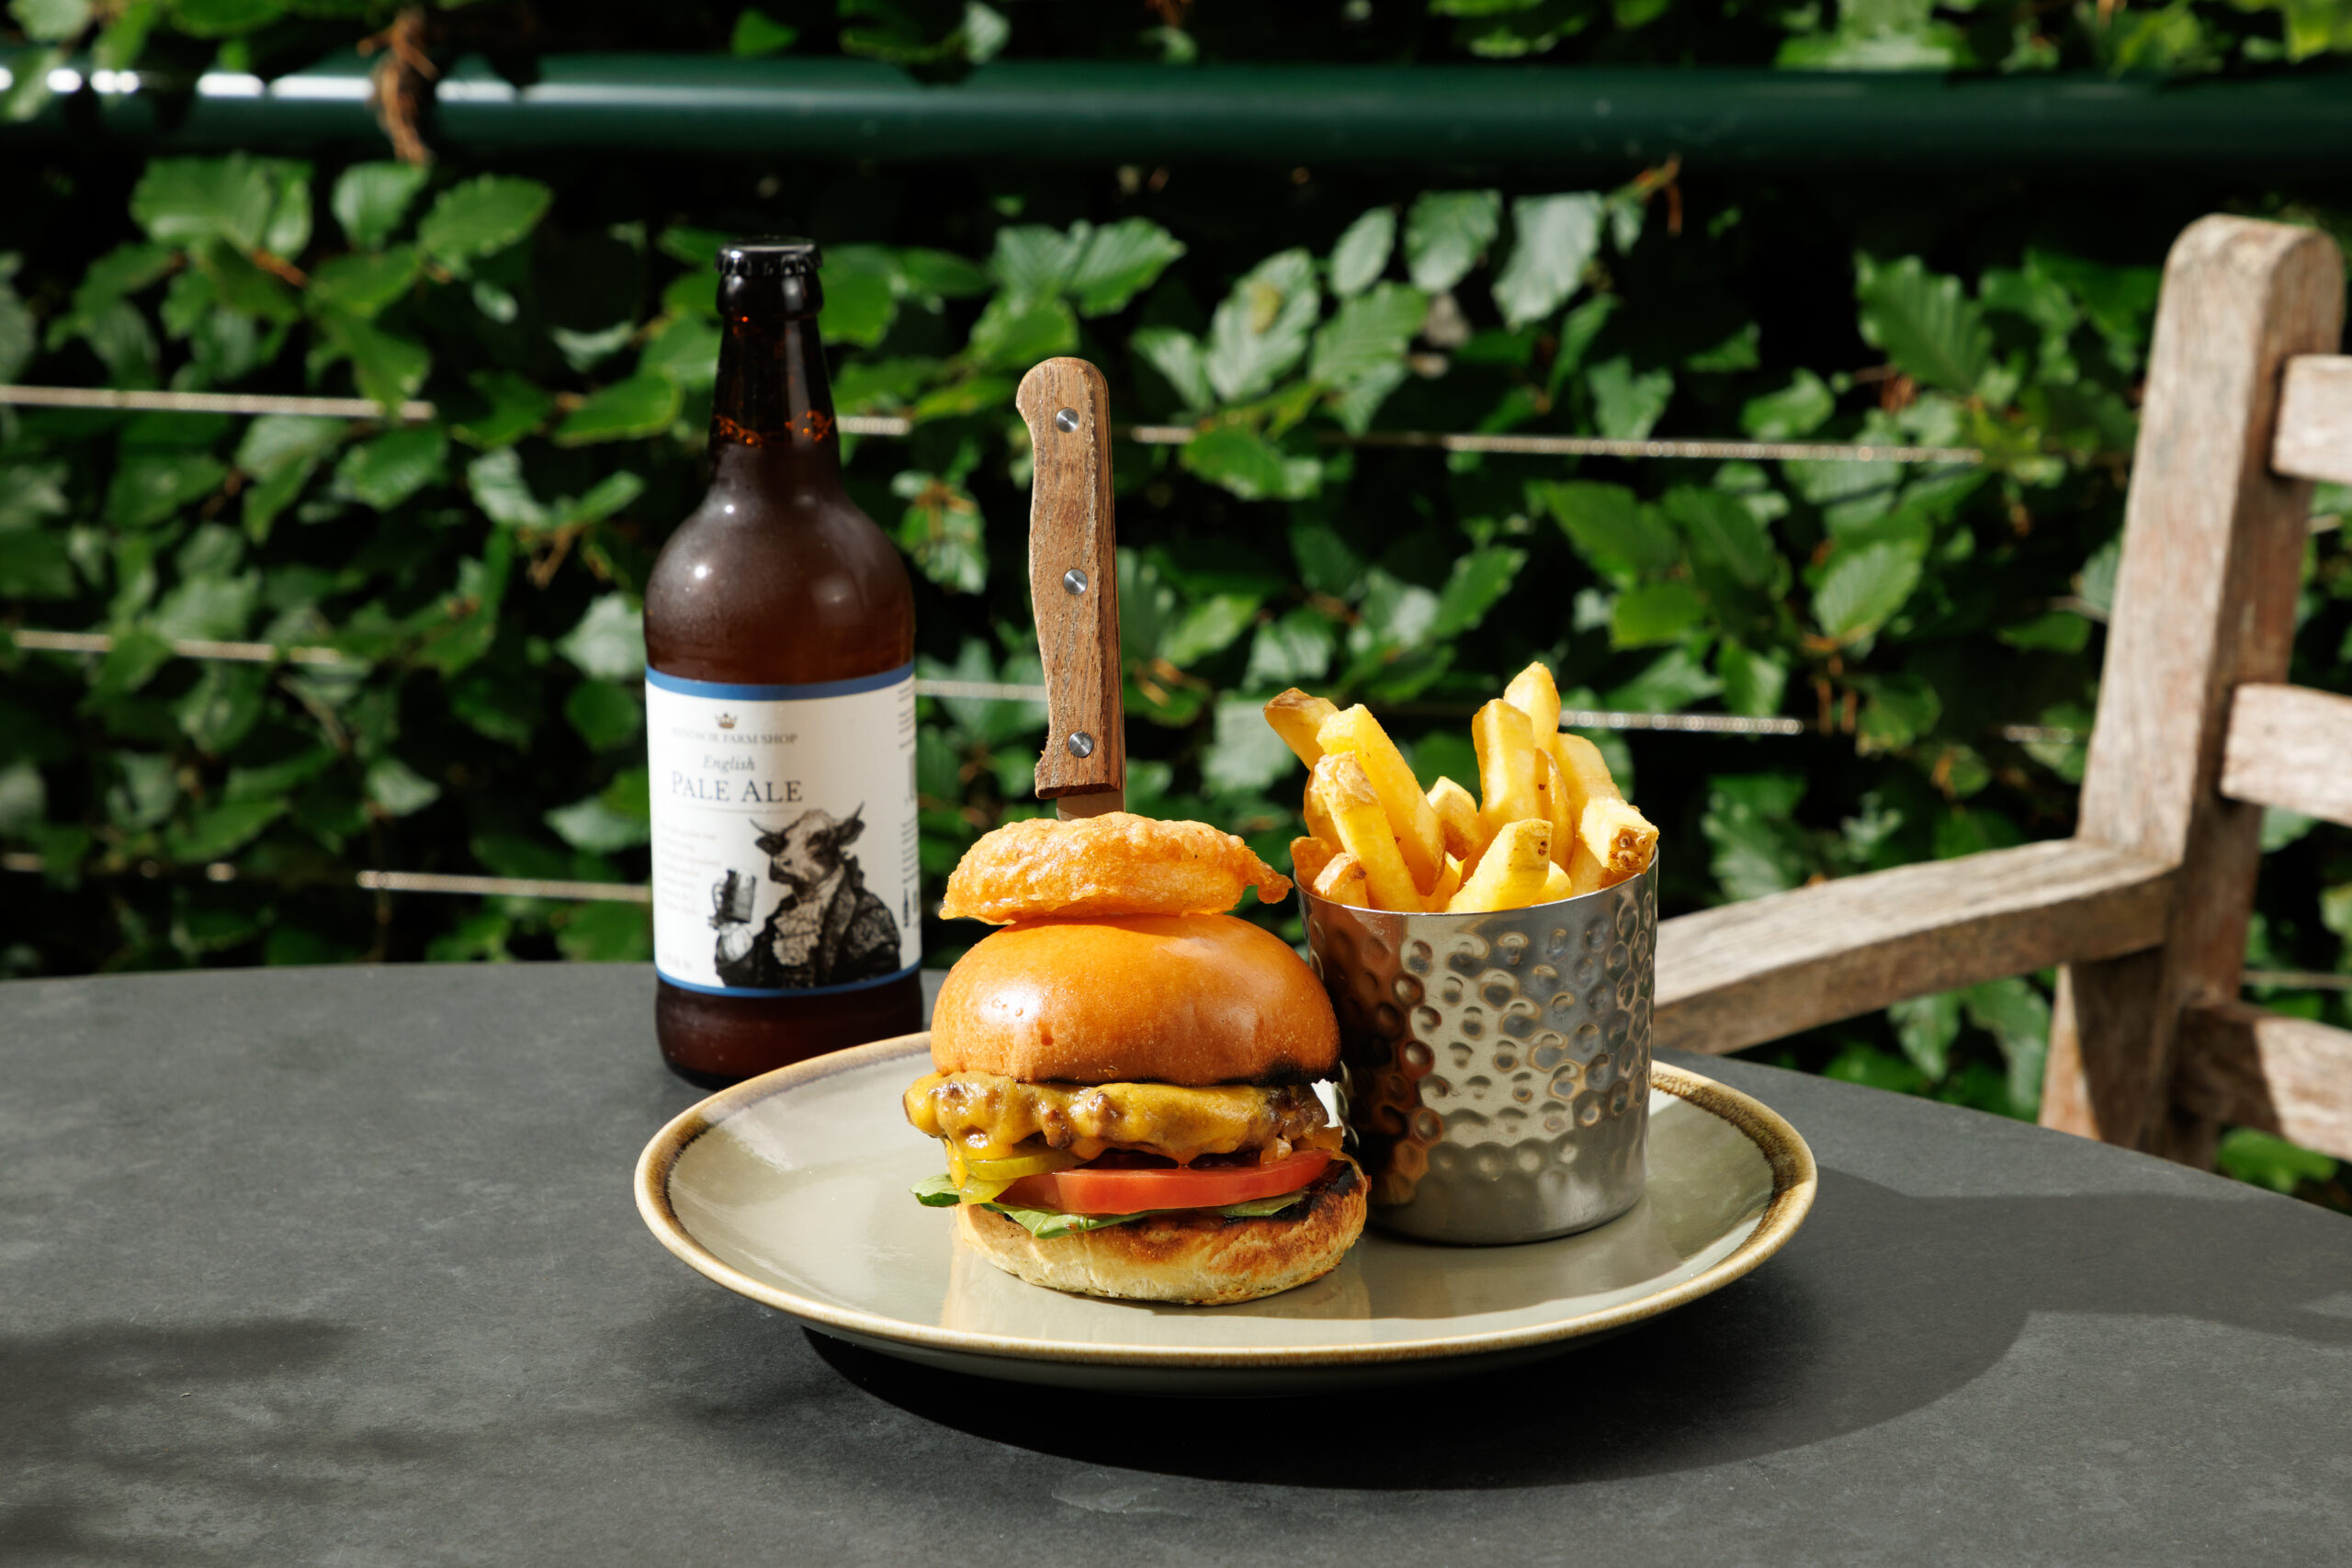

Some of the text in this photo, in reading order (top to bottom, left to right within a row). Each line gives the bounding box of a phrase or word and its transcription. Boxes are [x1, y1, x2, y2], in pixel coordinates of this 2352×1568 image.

[723, 733, 758, 744] FARM
[761, 732, 798, 744] SHOP
[703, 754, 755, 773] English
[672, 770, 803, 803] PALE ALE
